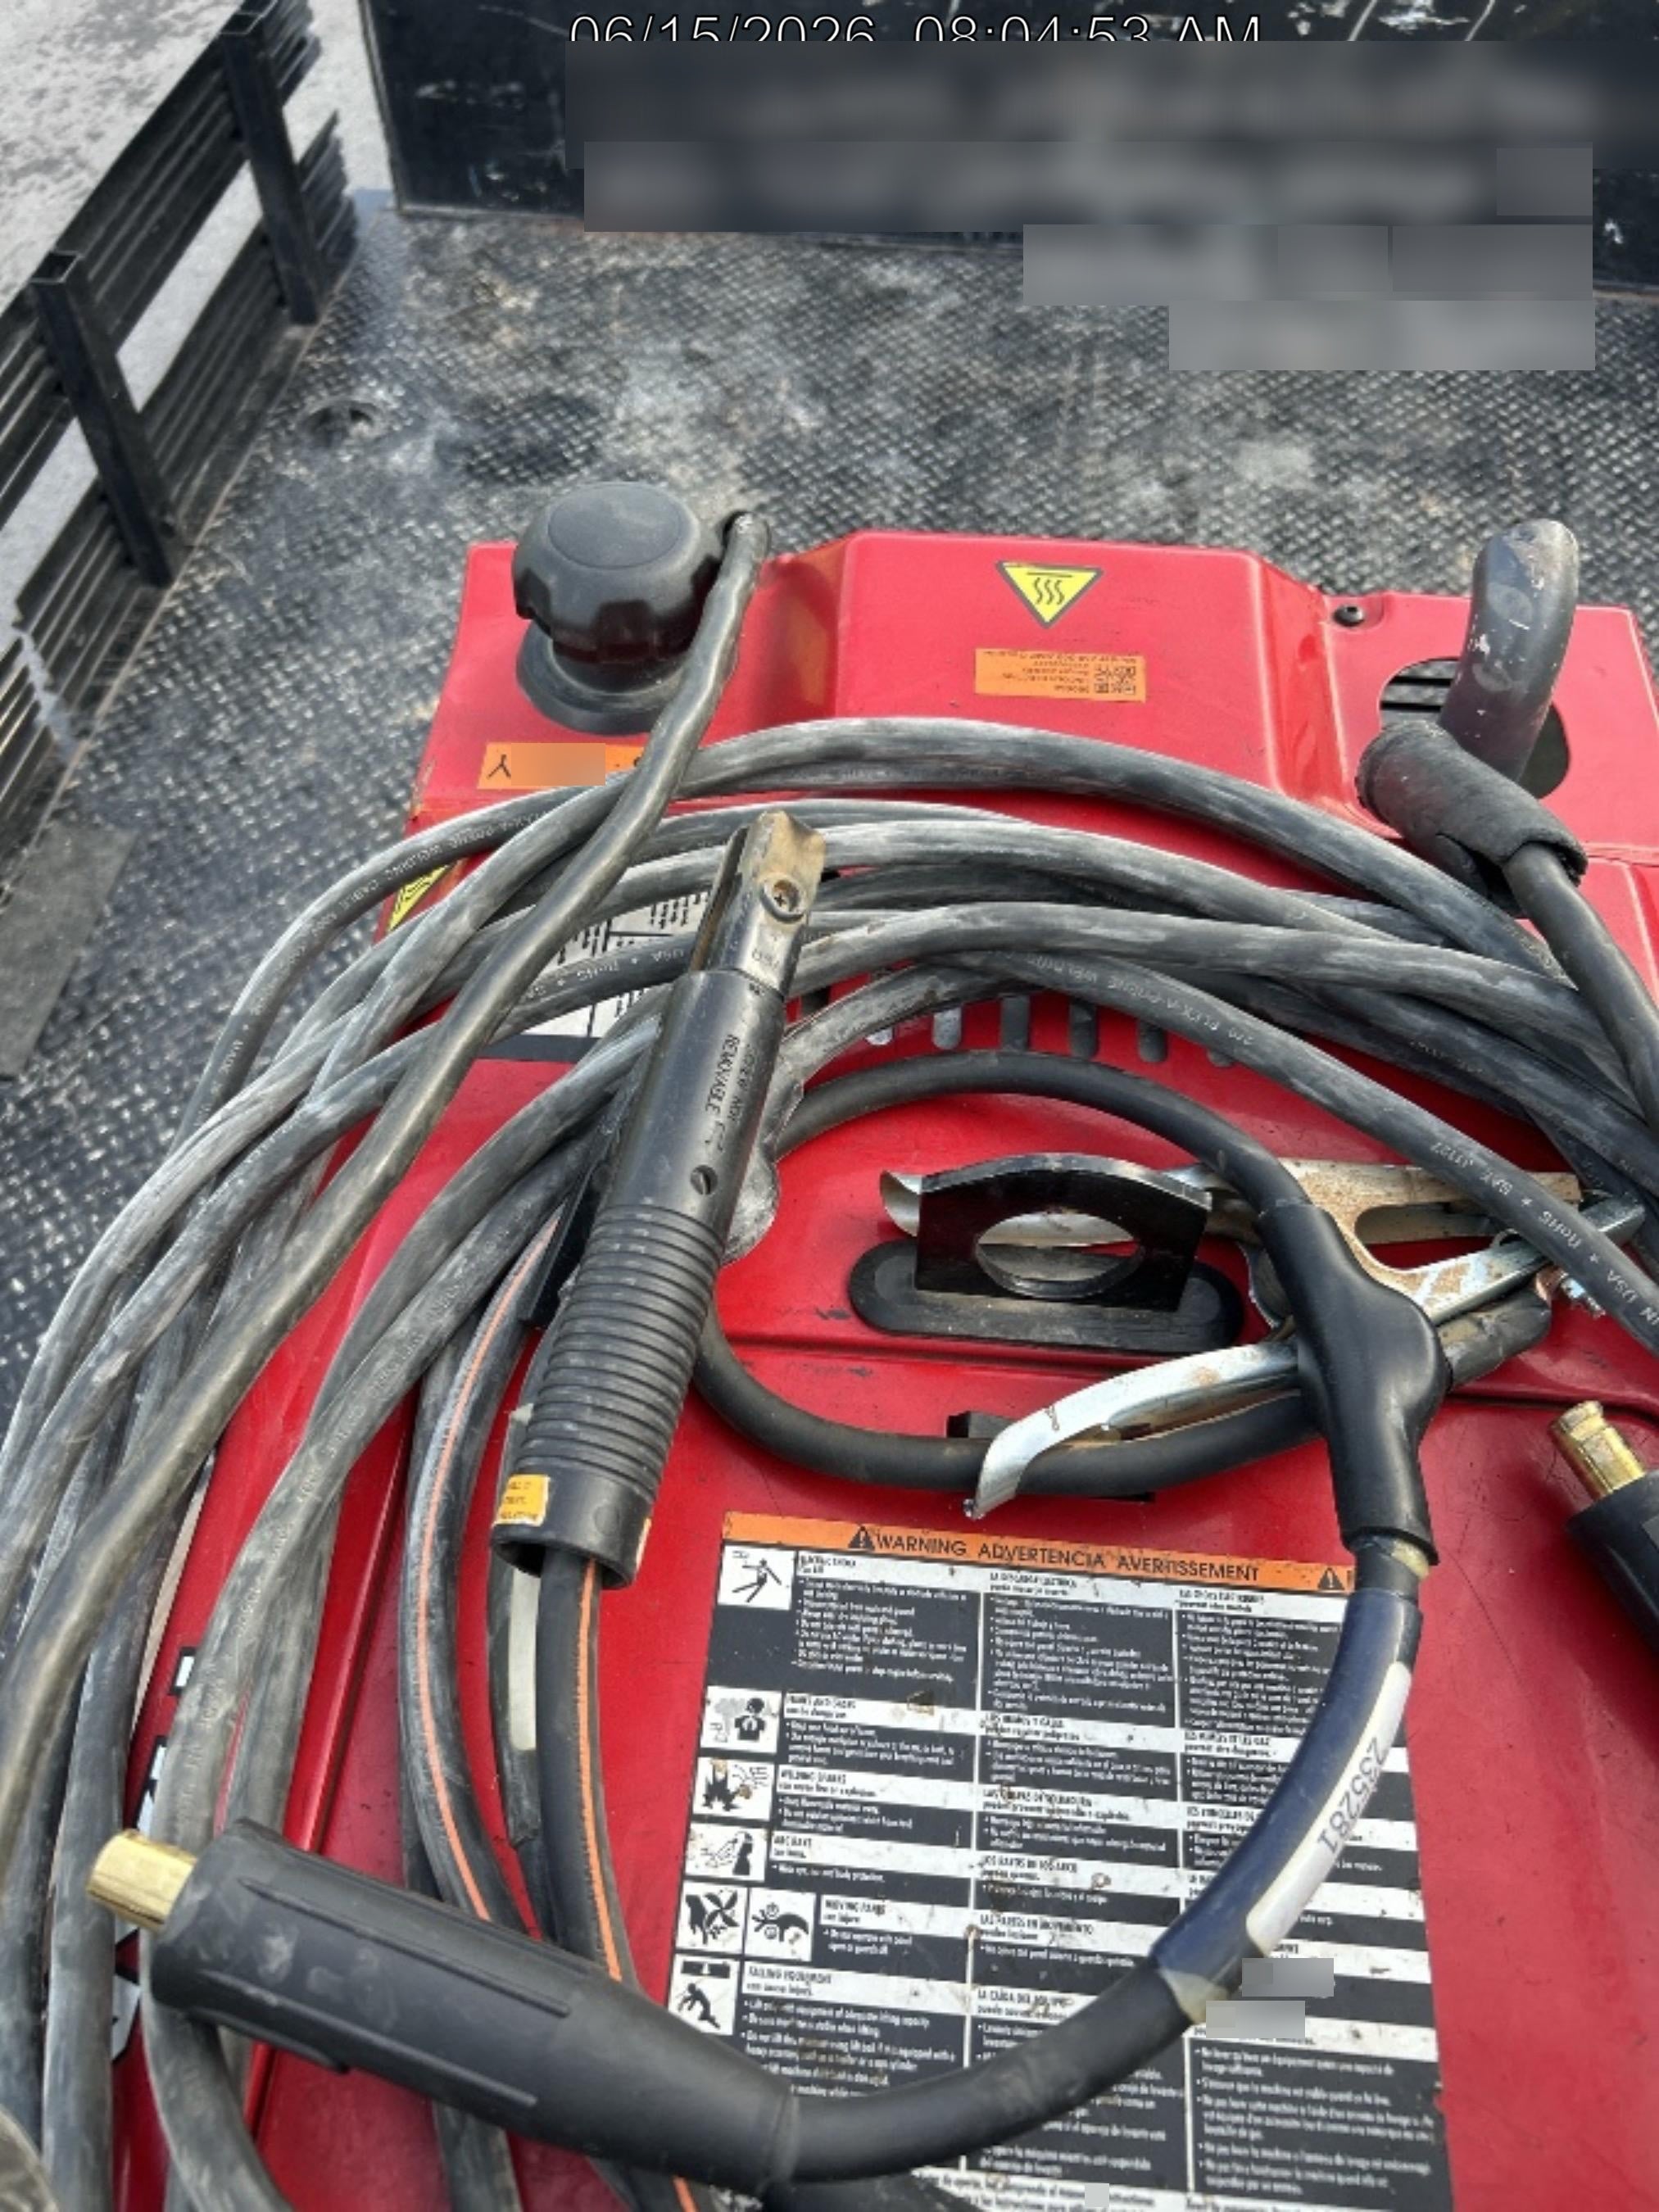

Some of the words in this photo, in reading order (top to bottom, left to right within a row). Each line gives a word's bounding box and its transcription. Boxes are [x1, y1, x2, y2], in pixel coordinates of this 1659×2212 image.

[1605, 1270, 1638, 1305] USA
[876, 1534, 968, 1557] WARNING
[977, 1541, 1106, 1571] ADVERTENCIA
[1116, 1555, 1260, 1583] AVERTISSEMENT
